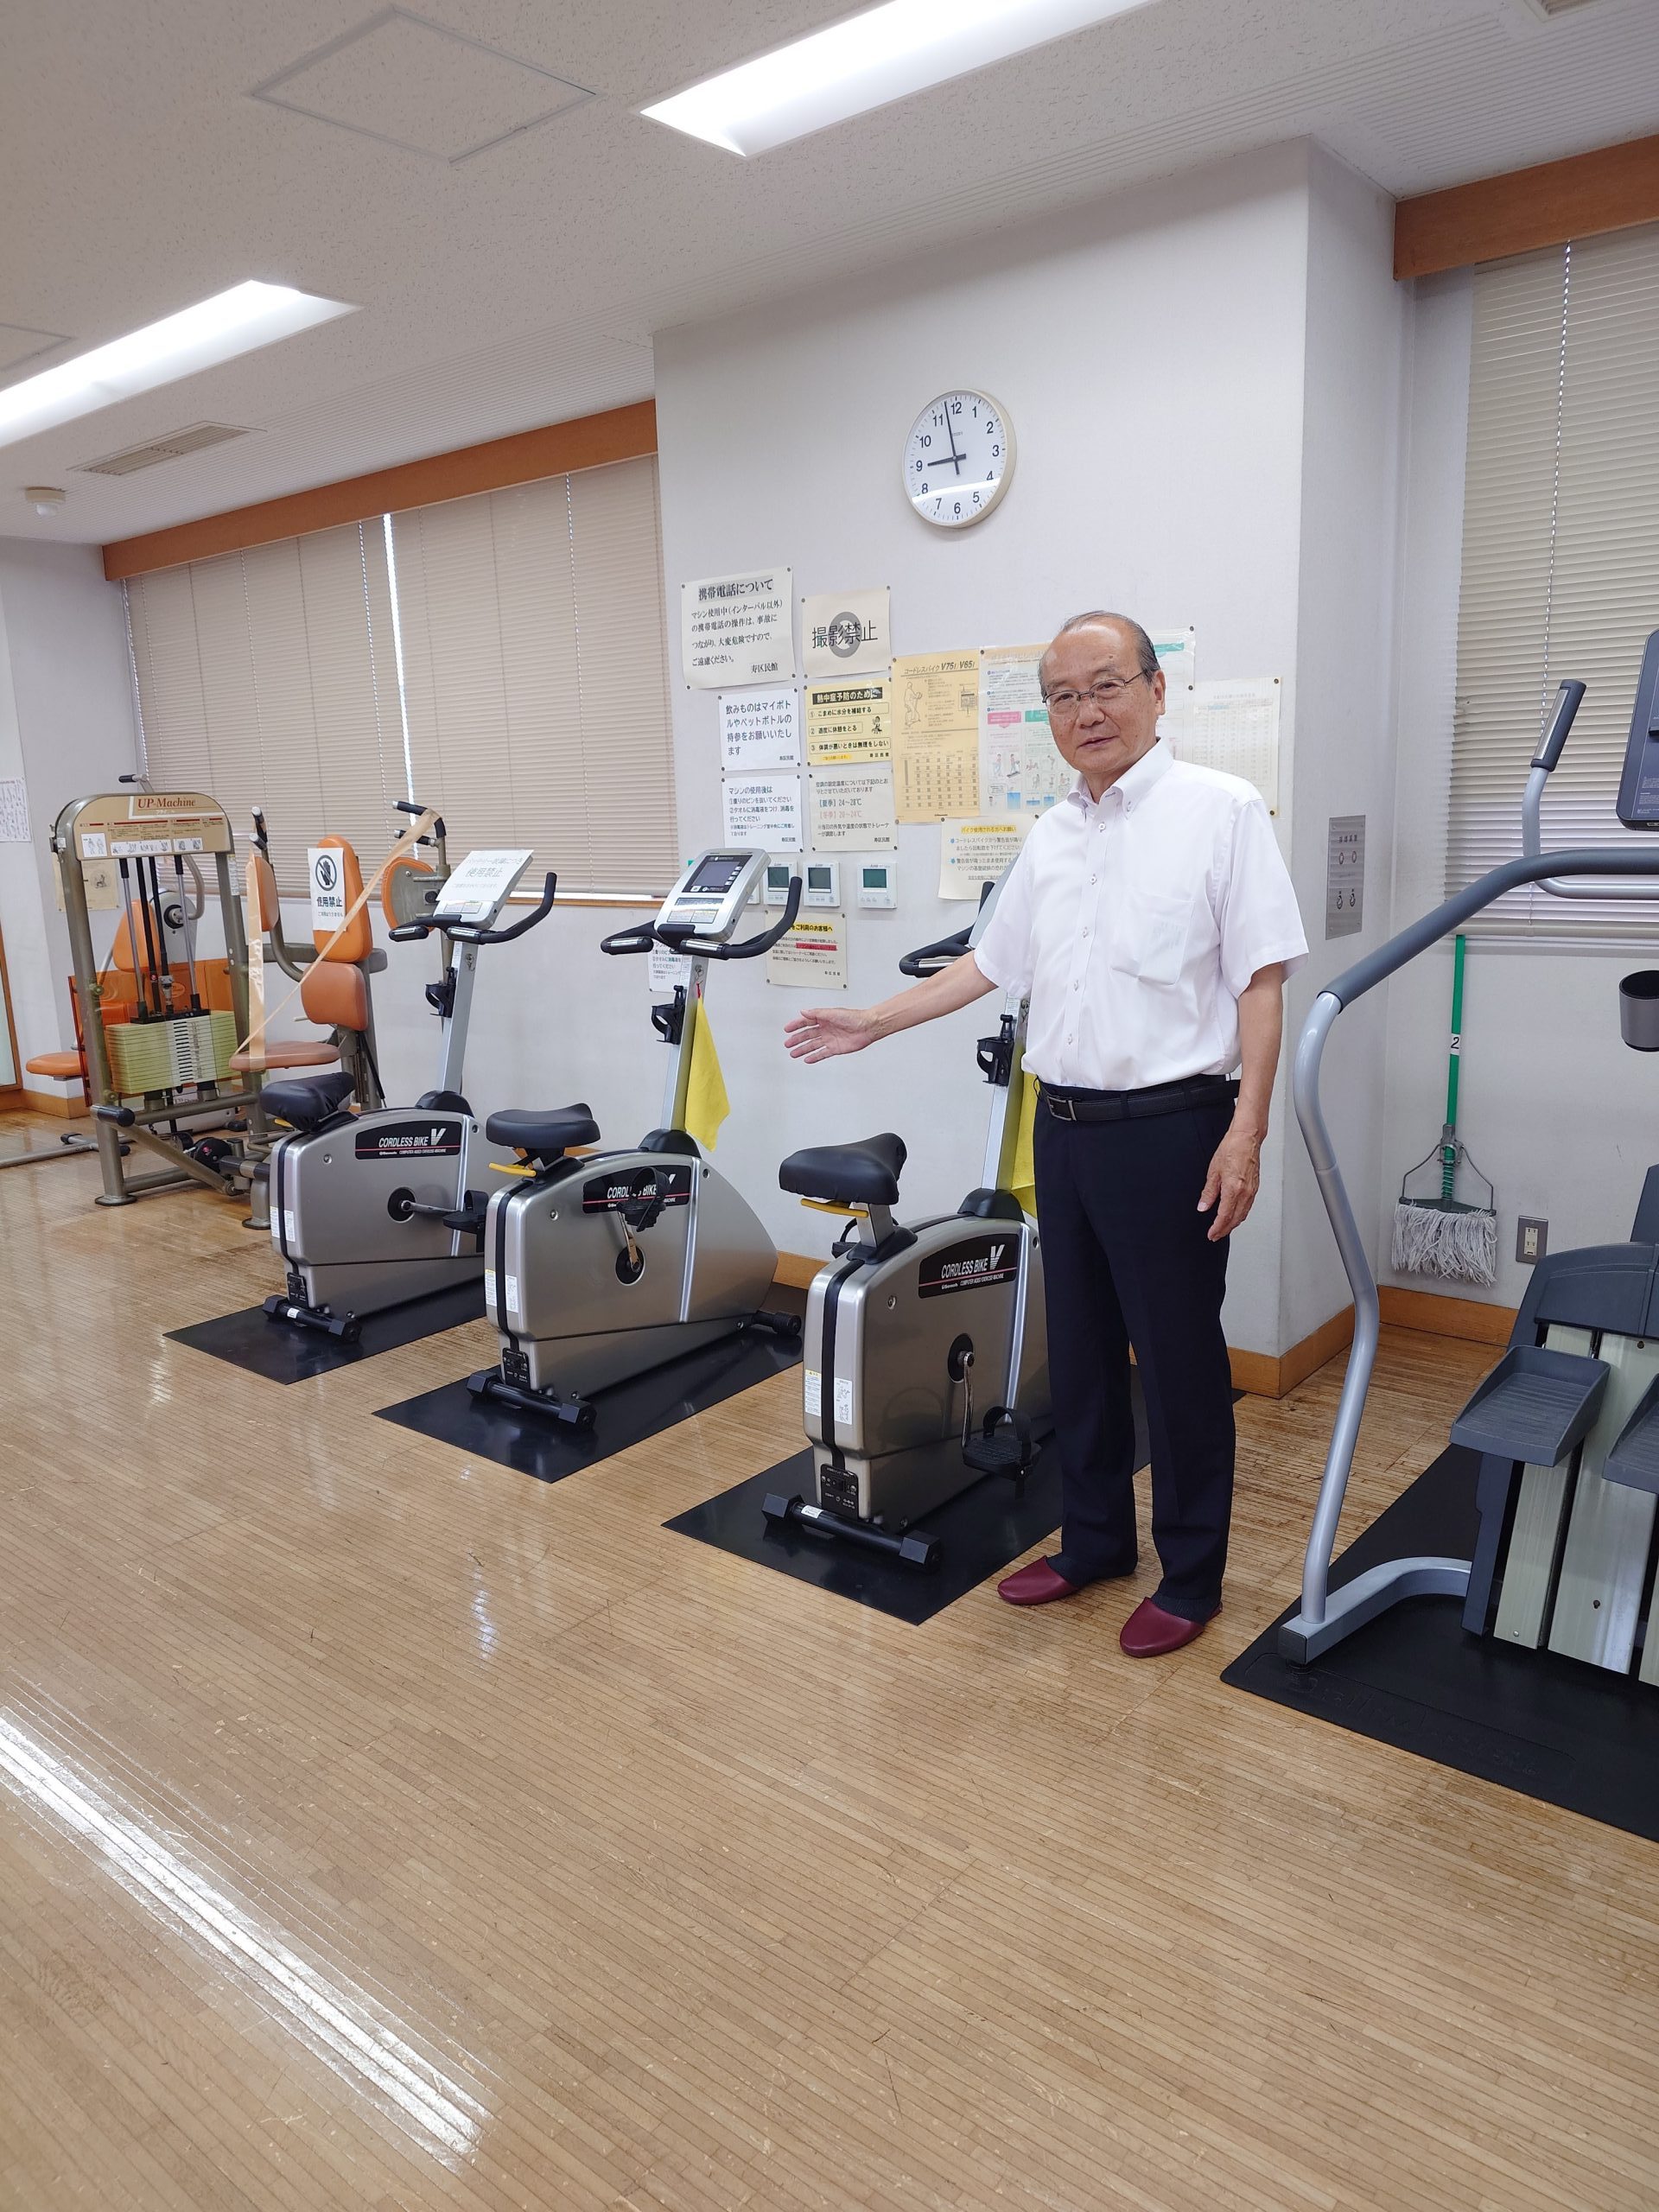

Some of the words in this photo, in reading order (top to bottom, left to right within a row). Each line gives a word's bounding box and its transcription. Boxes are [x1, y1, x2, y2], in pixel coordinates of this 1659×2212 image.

[950, 402, 962, 415] 12
[972, 406, 977, 418] 1
[933, 414, 944, 427] 11
[986, 421, 994, 434] 2
[919, 435, 931, 448] 10
[992, 445, 1000, 457] 3
[916, 460, 923, 472] 9
[986, 471, 994, 480] 4
[921, 483, 929, 494] 8
[973, 492, 980, 503] 5
[936, 498, 942, 510] 7
[954, 502, 961, 514] 6
[698, 578, 773, 601] 携帯電話について
[812, 620, 878, 649] 撮影禁止
[692, 654, 734, 667] ご遠慮ください。
[751, 663, 778, 675] 寿区民館
[904, 664, 939, 675] コードレスバイク
[817, 689, 878, 703] 熱中症予防のために
[726, 700, 791, 715] 飲みものはマイボト
[817, 707, 872, 717] こまめに水分を補給する
[727, 714, 792, 728] ルやペットボトルの
[727, 728, 792, 743] 持参をお願いいたし
[728, 747, 741, 756] ます
[728, 786, 773, 795] マシンの使用後は
[316, 896, 343, 907] 使用禁止
[1451, 1037, 1459, 1050] 2
[378, 1136, 413, 1147] CORDLESS
[413, 1136, 429, 1147] BIKE
[607, 1185, 642, 1199] CORDL
[941, 1260, 974, 1279] CORDLESS
[973, 1257, 988, 1273] BIKE
